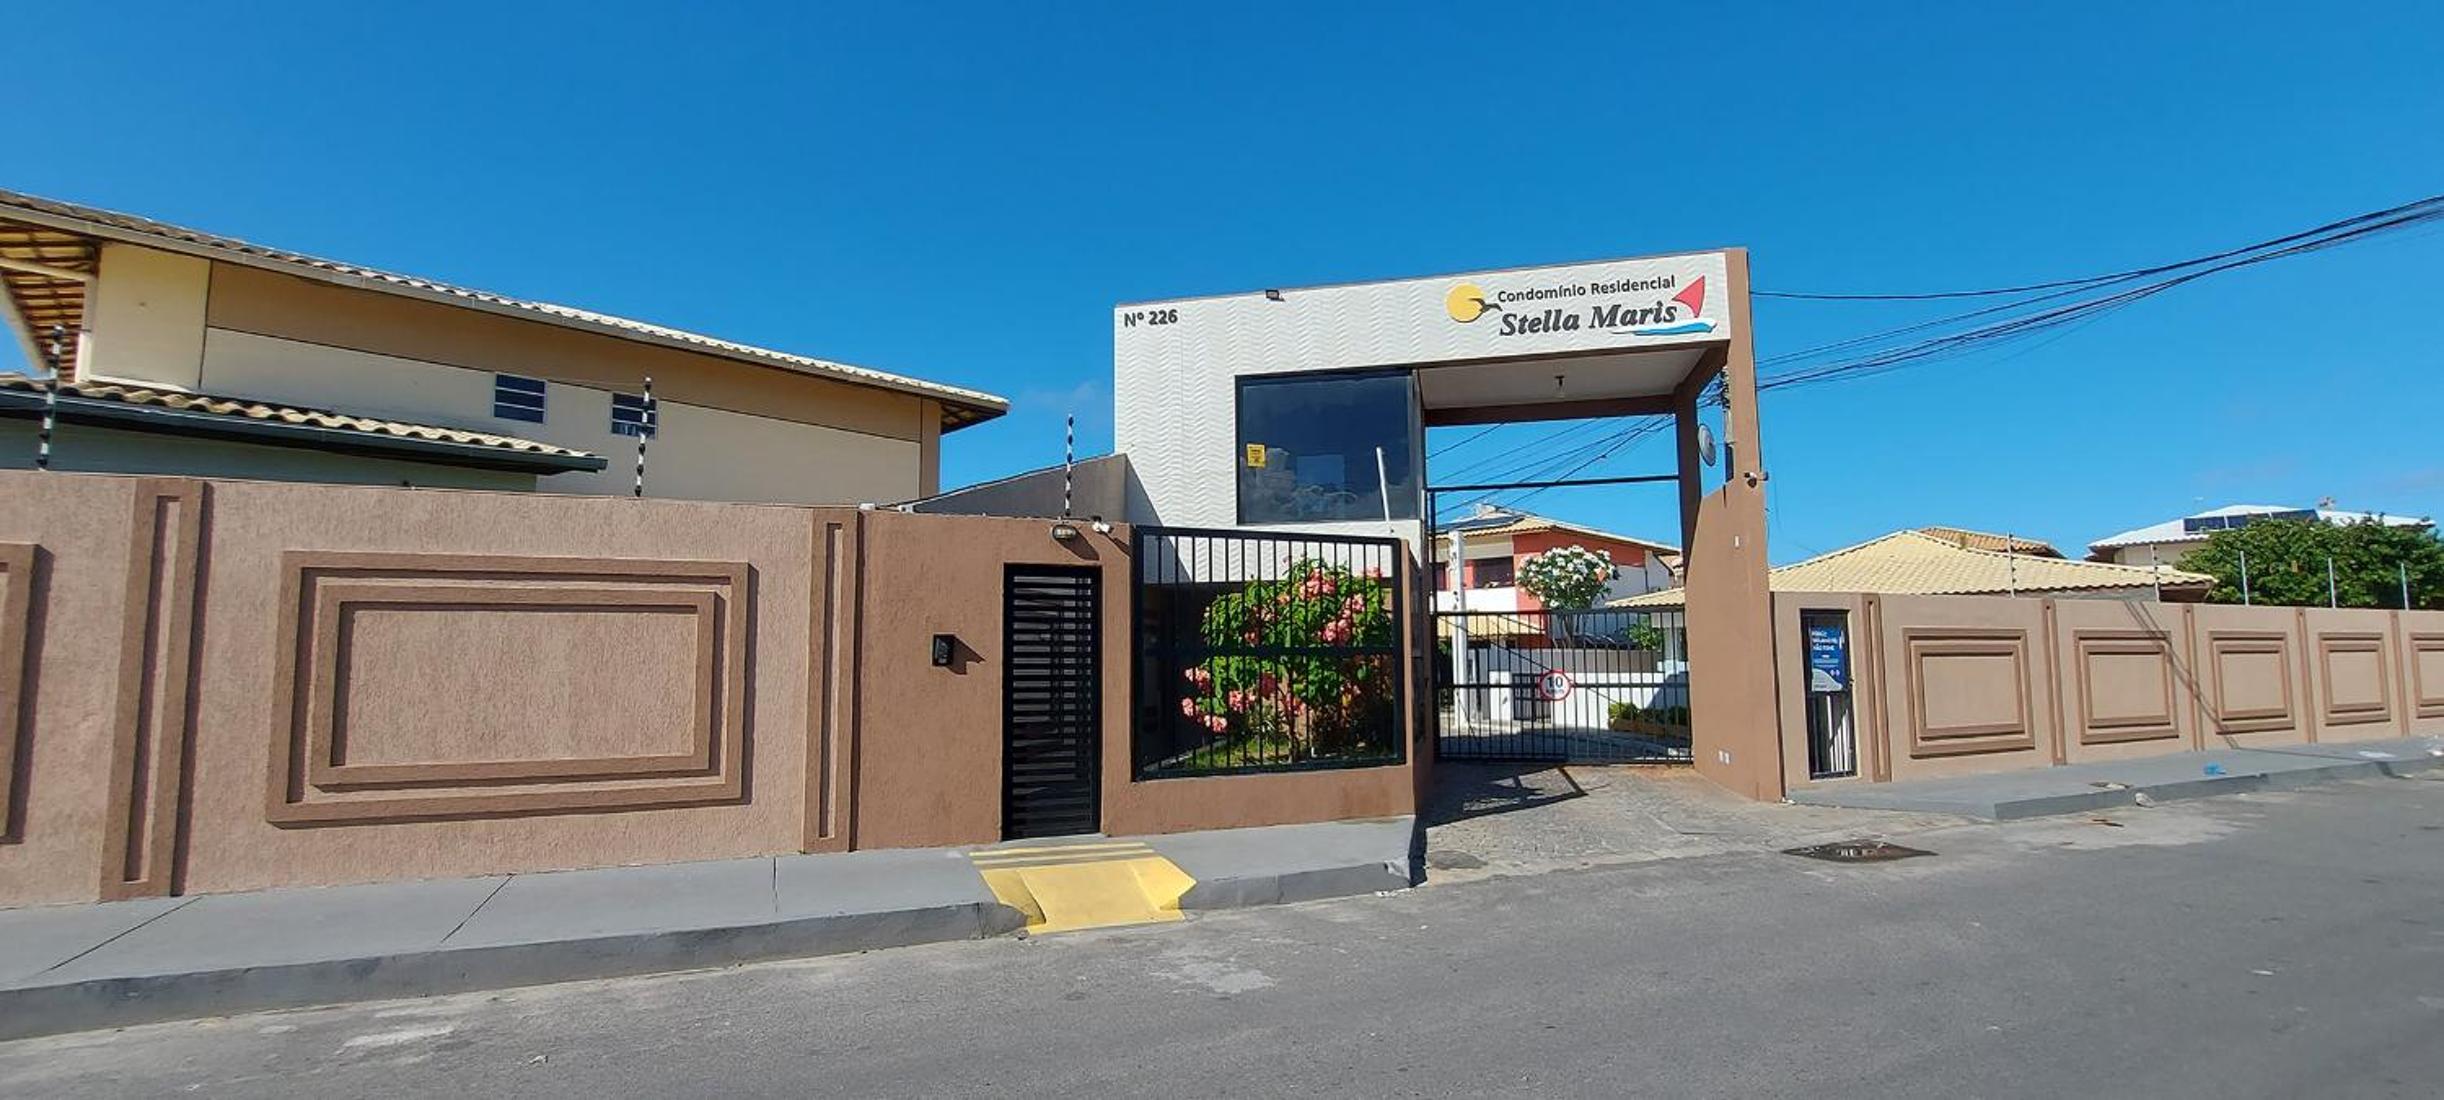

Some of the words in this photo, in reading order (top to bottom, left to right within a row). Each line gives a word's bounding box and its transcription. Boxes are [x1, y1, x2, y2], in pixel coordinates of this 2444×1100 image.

[1498, 284, 1586, 303] Condomínio
[1591, 276, 1676, 295] Residencial
[1148, 309, 1178, 325] 226
[1500, 309, 1580, 336] Stella
[1589, 301, 1678, 329] Maris
[1547, 676, 1563, 688] 10
